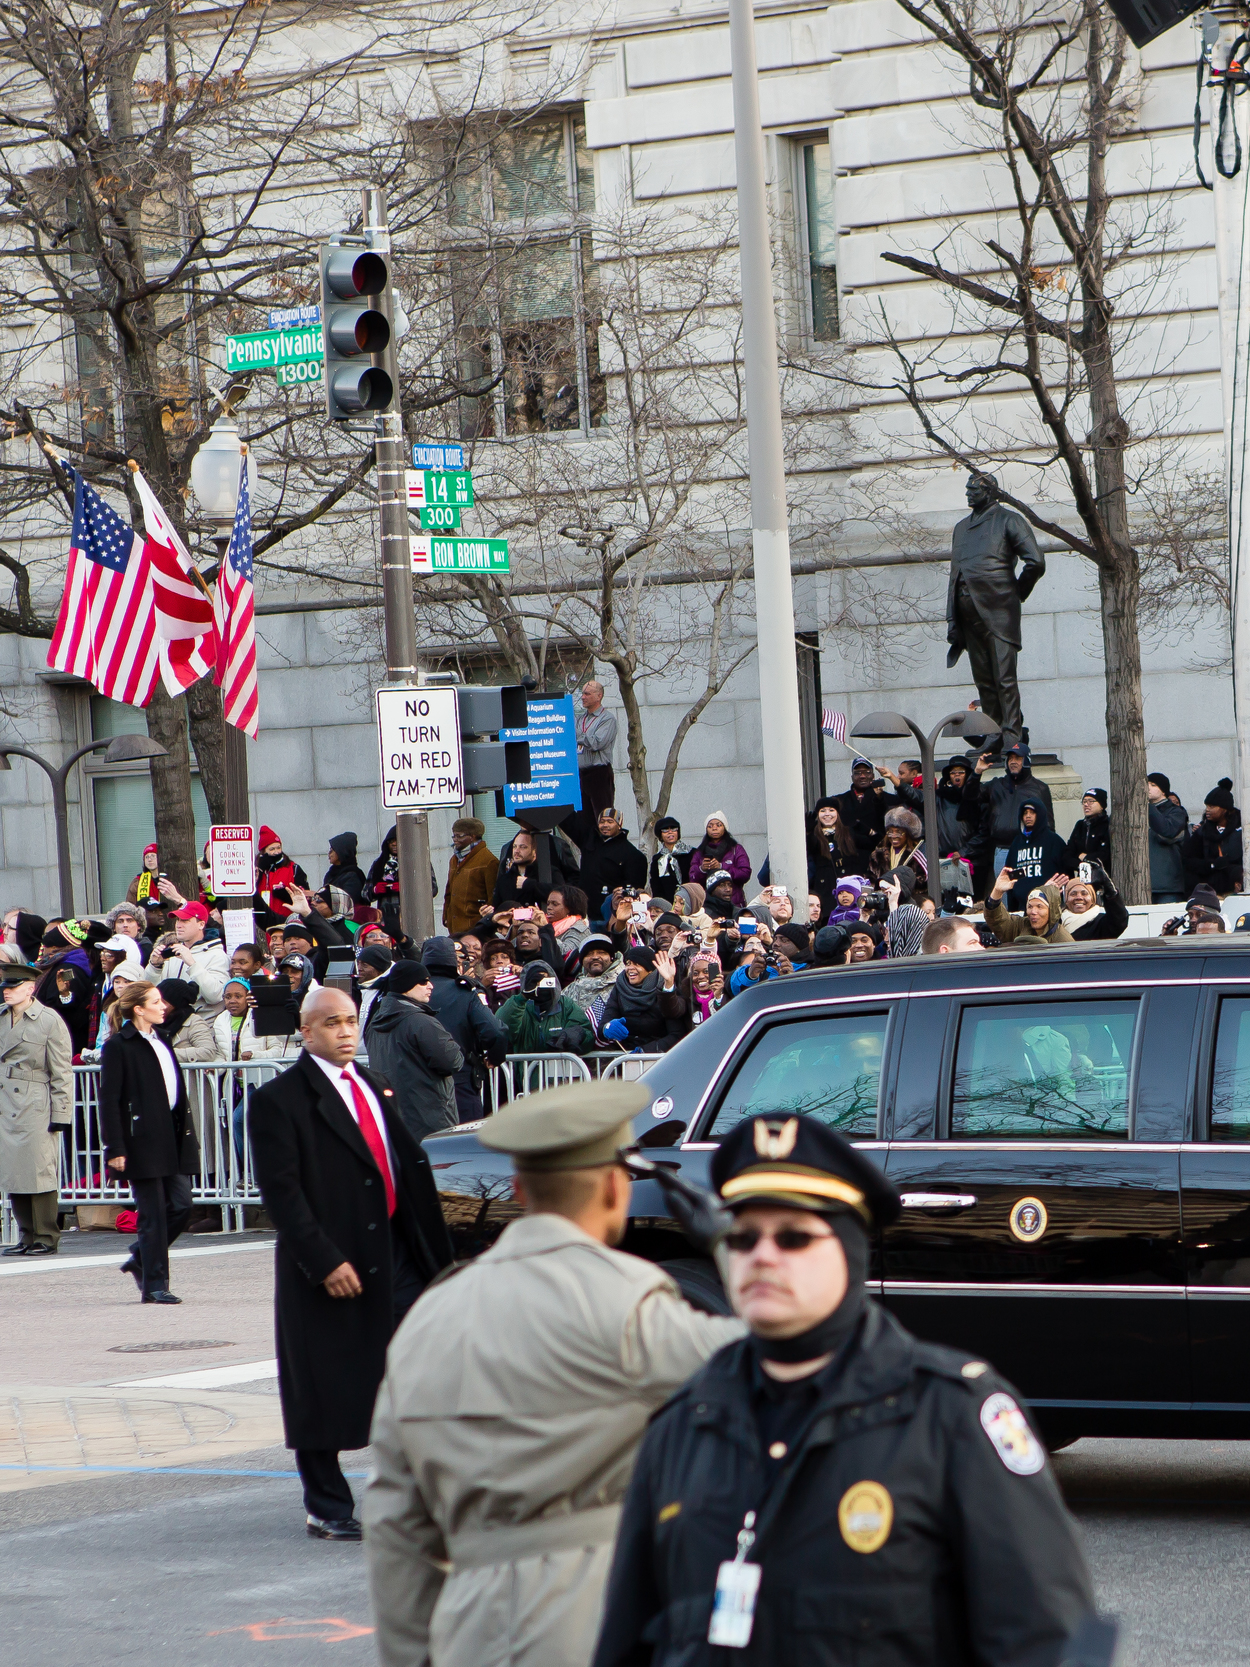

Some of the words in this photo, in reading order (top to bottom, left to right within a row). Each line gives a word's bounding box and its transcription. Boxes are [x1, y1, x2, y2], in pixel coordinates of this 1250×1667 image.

[271, 309, 300, 324] EVACUATION
[300, 306, 317, 319] ROUTE
[227, 328, 324, 365] Pennsylvania
[279, 361, 320, 383] 1300
[414, 446, 444, 465] EVACUATION
[445, 447, 462, 467] ROUTE
[431, 476, 448, 502] 14
[456, 477, 466, 489] ST
[456, 490, 468, 502] NW
[427, 507, 454, 526] 300
[434, 542, 455, 567] RON
[457, 542, 491, 568] BROWN
[493, 550, 505, 562] WAY
[405, 700, 430, 717] NO
[531, 703, 553, 712] Aquarium
[546, 715, 566, 723] Building
[399, 725, 440, 743] TURN
[528, 727, 556, 735] Information
[556, 726, 564, 734] Ctr.
[529, 739, 542, 747] tional
[391, 752, 412, 770] ON
[420, 751, 451, 769] RED
[386, 776, 459, 797] 7AM-7PM
[522, 781, 541, 789] Federal
[541, 780, 560, 789] Triangle
[539, 792, 555, 800] Center
[215, 828, 249, 839] RESERVED
[1017, 846, 1042, 862] HOLLI
